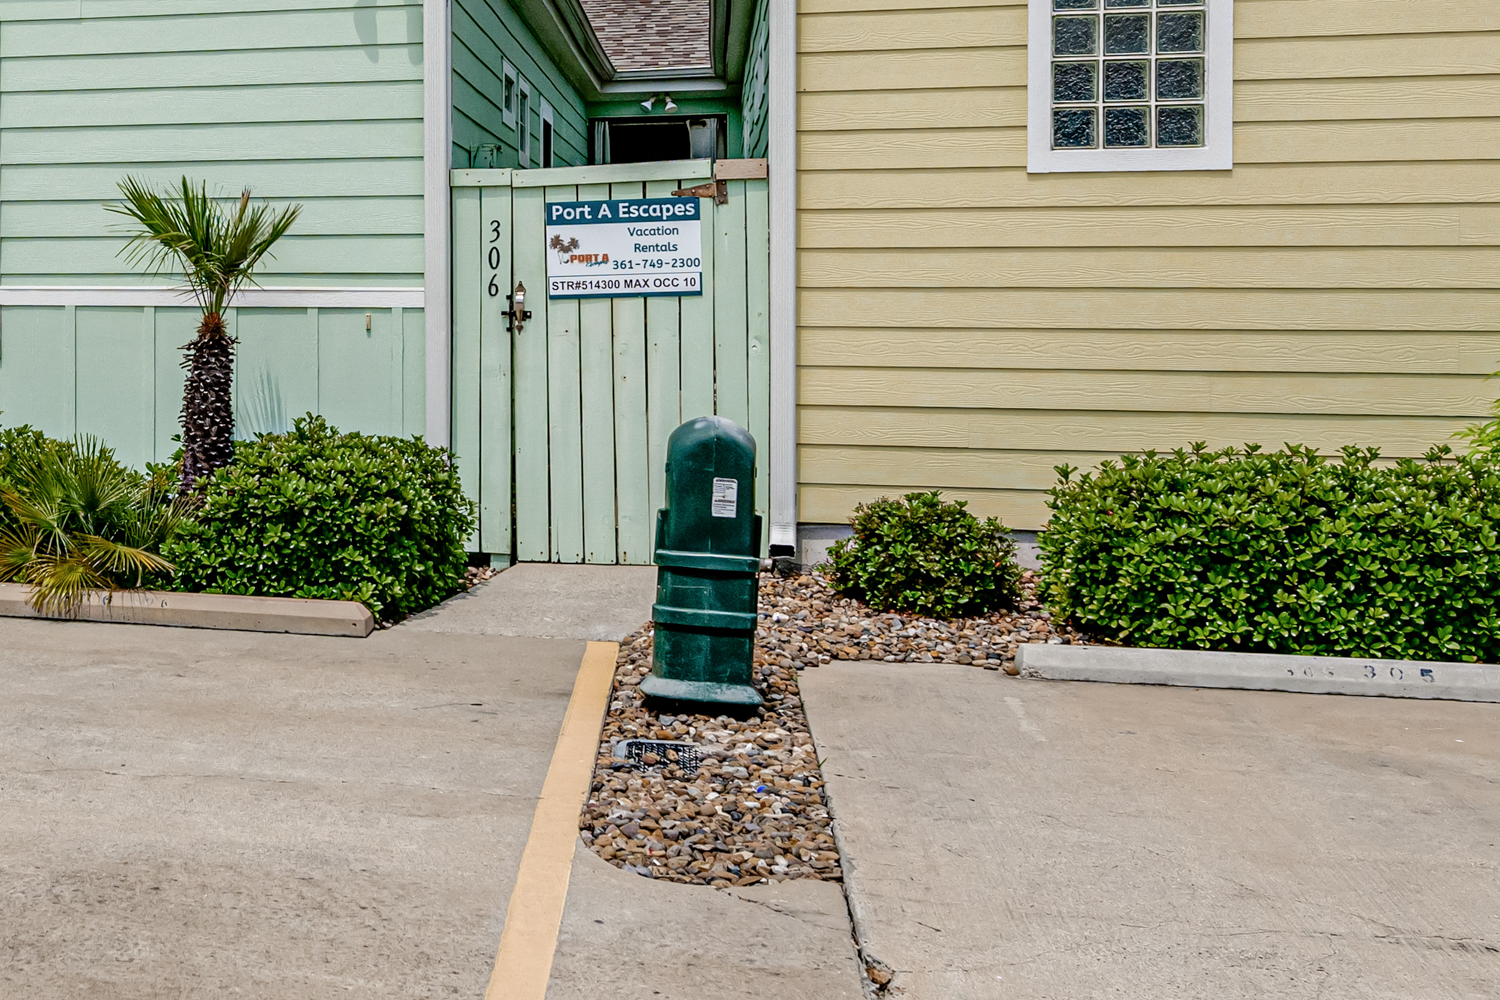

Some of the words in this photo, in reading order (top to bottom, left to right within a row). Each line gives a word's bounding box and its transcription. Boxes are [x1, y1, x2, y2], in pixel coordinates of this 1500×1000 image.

[551, 204, 592, 221] Port
[597, 203, 612, 219] A
[618, 202, 696, 220] Escapes
[626, 225, 679, 237] Vacation
[633, 241, 678, 253] Rentals
[488, 220, 501, 297] 306
[570, 254, 600, 263] PORT
[602, 253, 610, 263] A
[611, 257, 701, 270] 361-749-2300
[551, 279, 620, 291] STR#514300
[623, 278, 650, 289] MAX
[653, 277, 680, 288] OCC
[684, 276, 696, 287] 10
